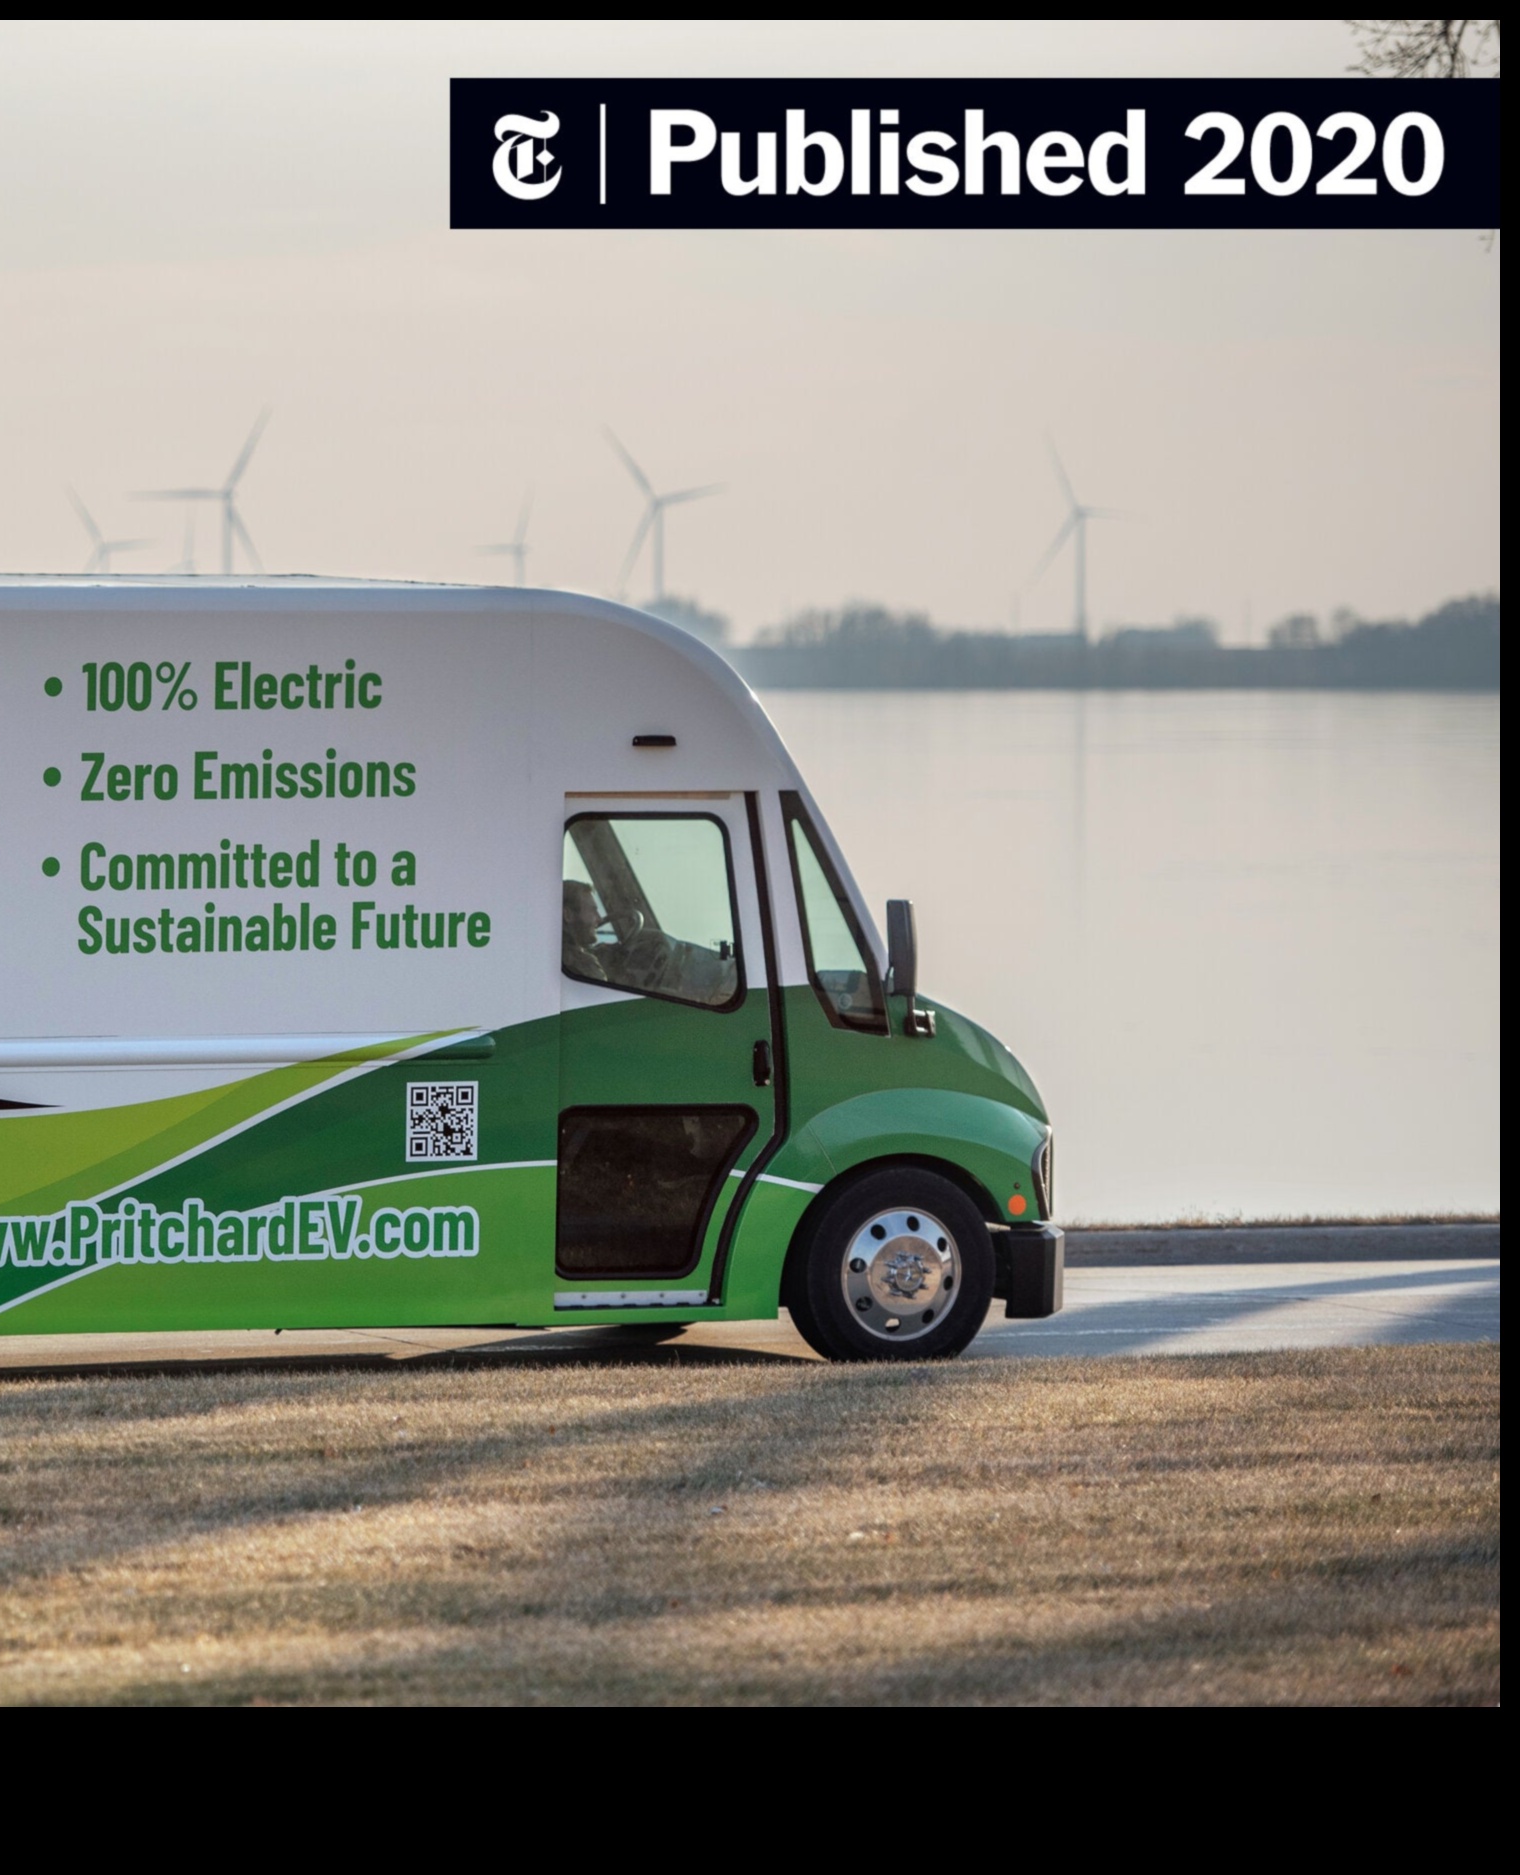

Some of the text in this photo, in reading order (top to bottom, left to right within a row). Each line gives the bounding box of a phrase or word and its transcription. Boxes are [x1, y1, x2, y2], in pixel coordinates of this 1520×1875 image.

[82, 658, 383, 712] 100% Electric
[80, 748, 417, 802] Zero Emissions
[80, 838, 416, 892] Committed to a
[77, 901, 492, 955] Sustainable Future
